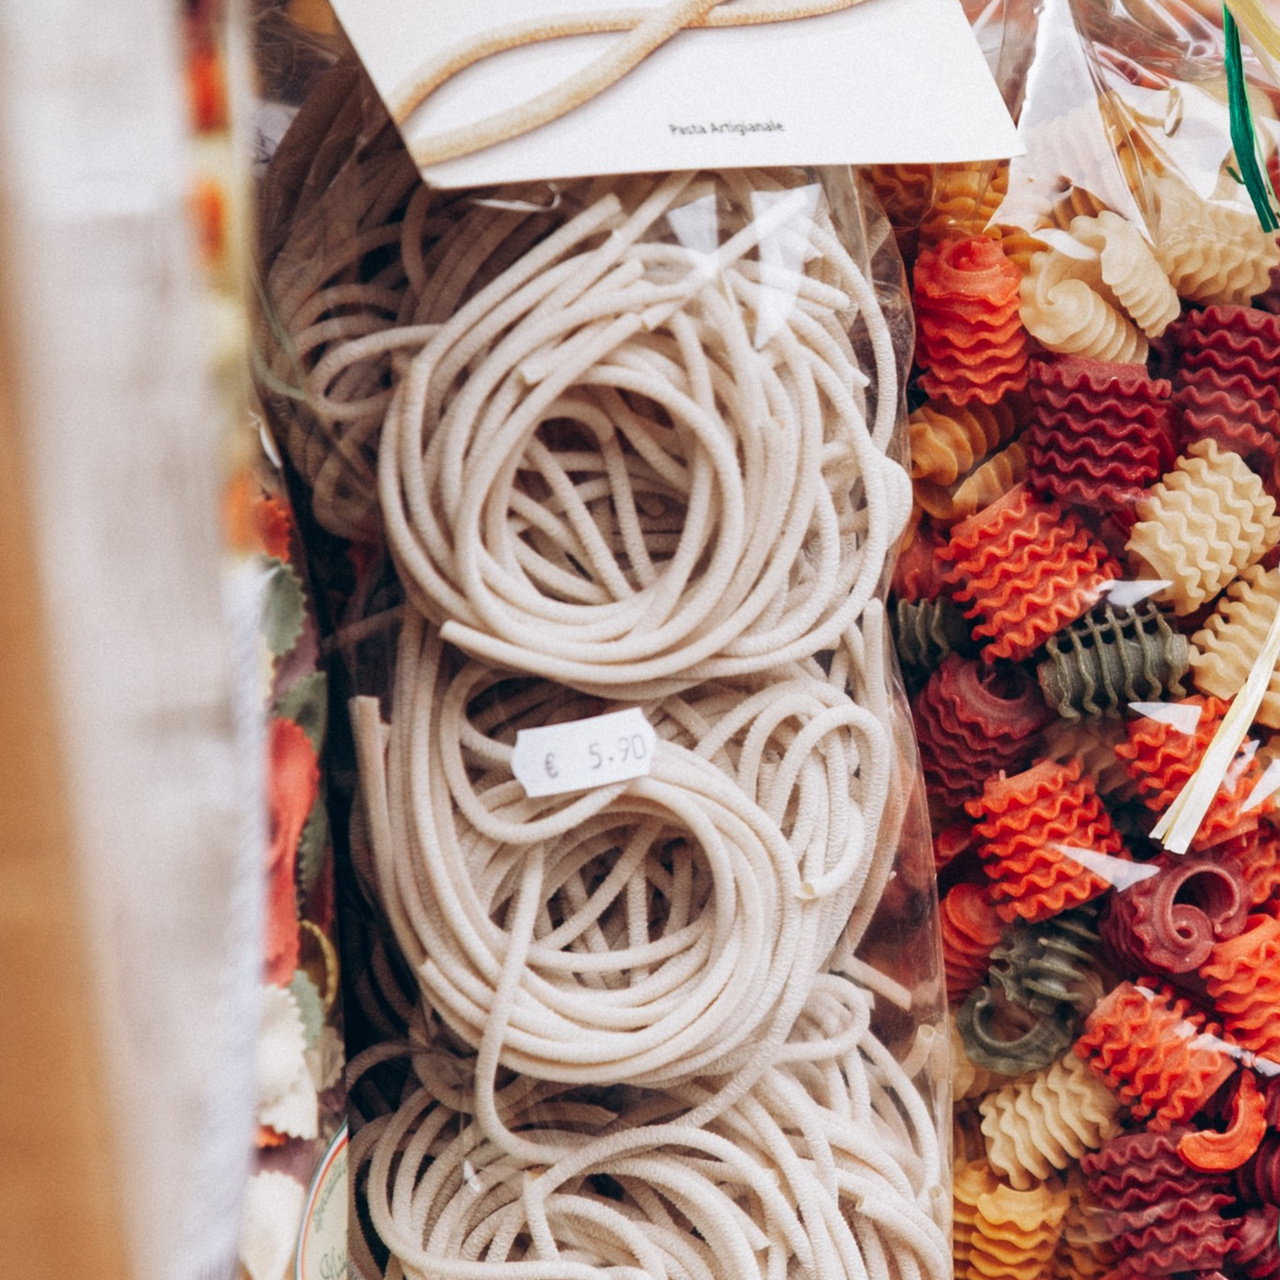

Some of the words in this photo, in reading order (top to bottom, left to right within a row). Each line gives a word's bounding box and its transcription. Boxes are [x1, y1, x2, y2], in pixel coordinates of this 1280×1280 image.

[668, 123, 707, 136] Pasta
[544, 751, 559, 778] €
[588, 733, 647, 770] 5.90
